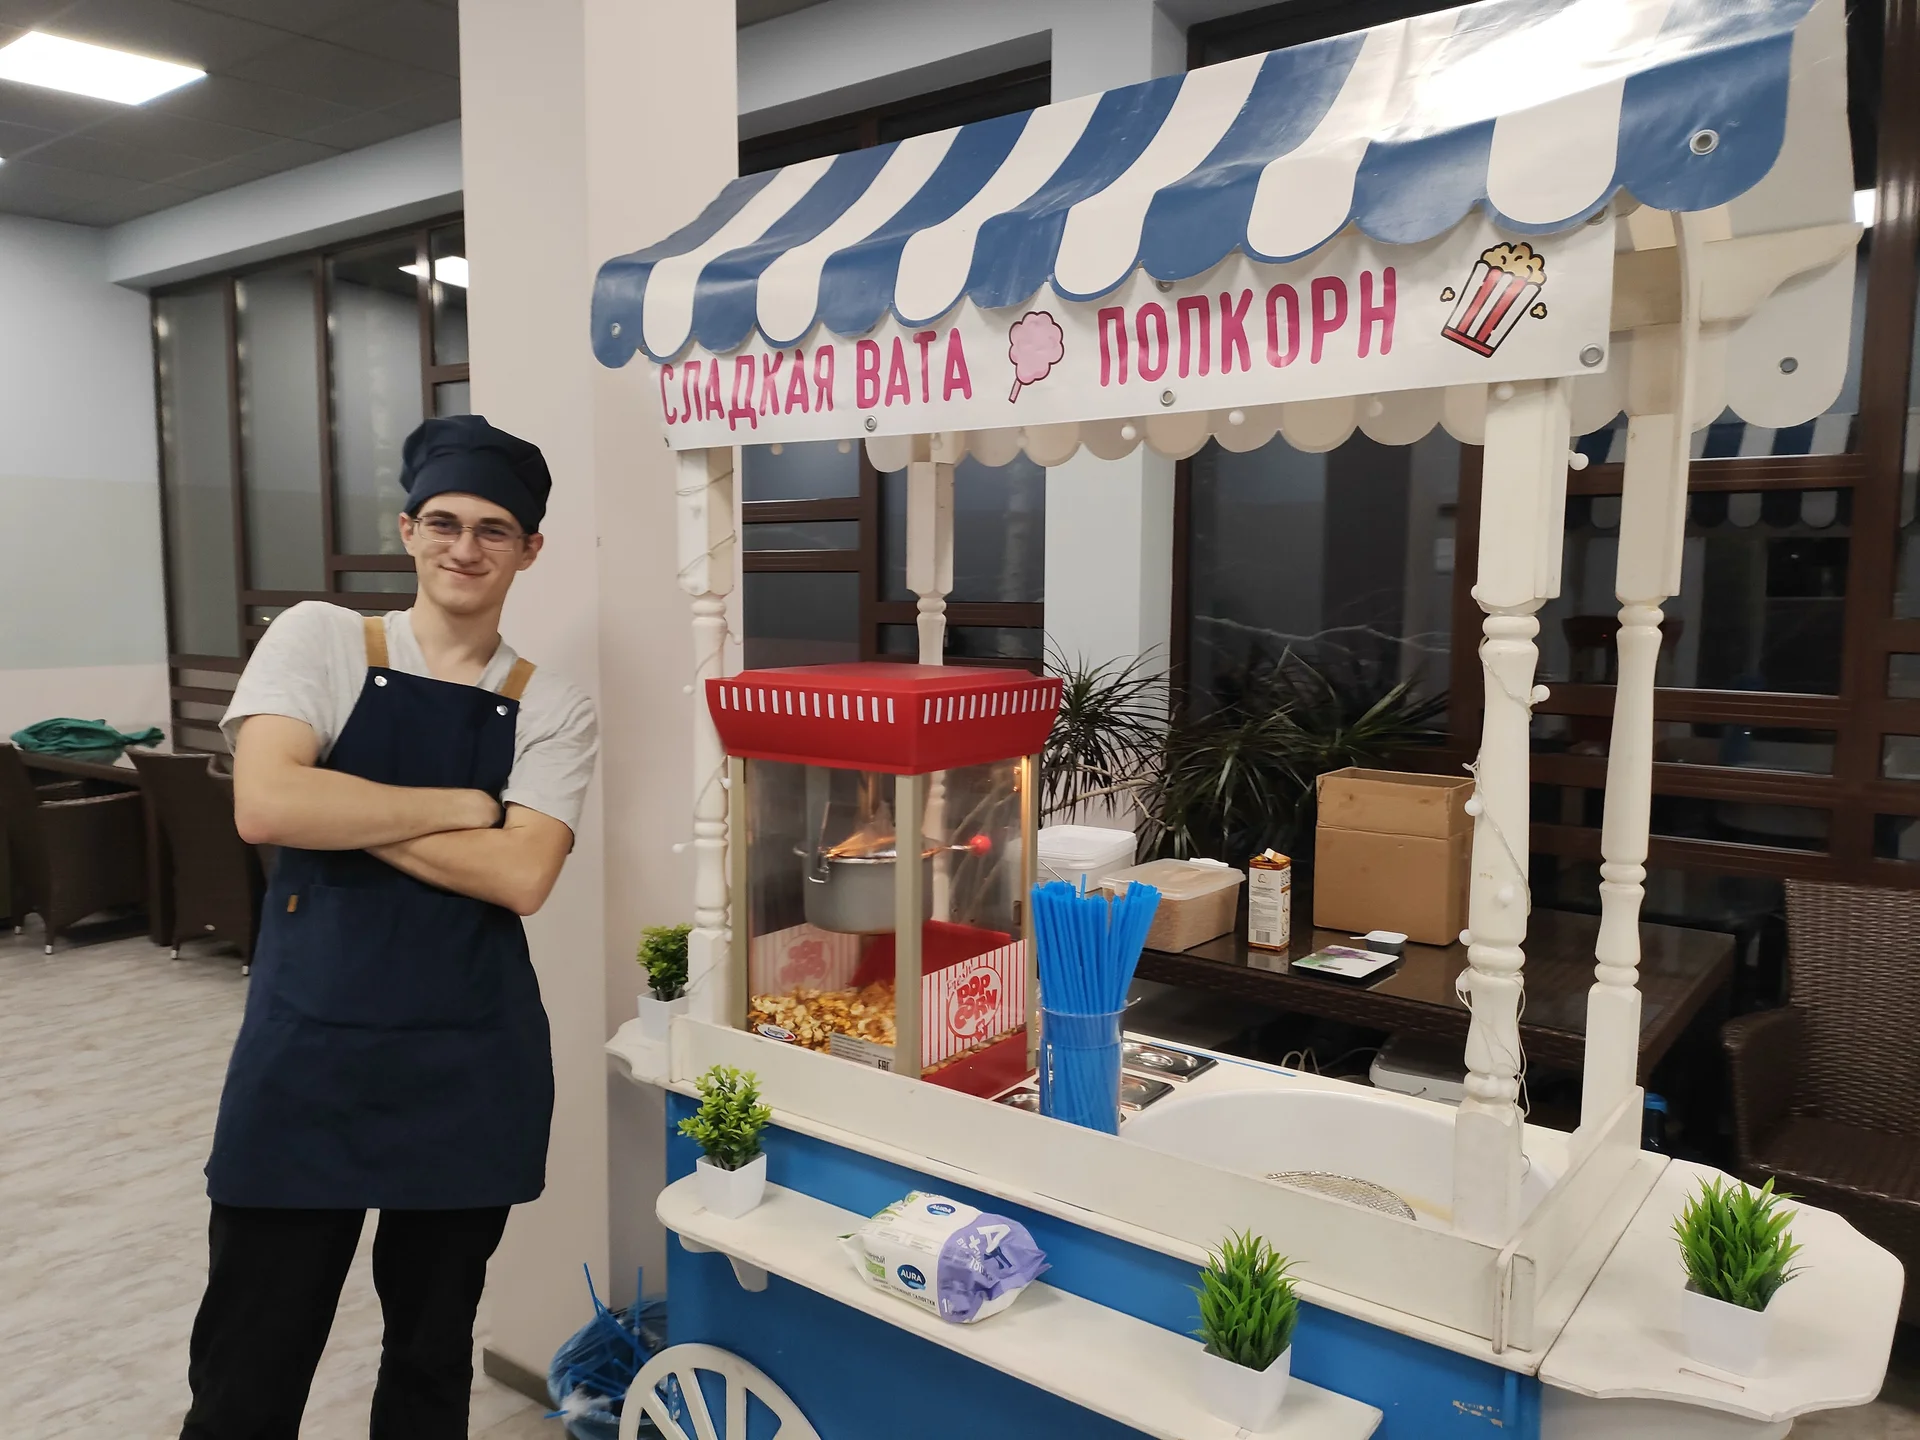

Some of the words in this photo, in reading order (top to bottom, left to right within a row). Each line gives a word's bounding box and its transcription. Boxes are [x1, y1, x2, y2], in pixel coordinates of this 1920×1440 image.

[1097, 266, 1397, 387] ПОПКОРН
[660, 344, 834, 431] СЛАДКАЯ
[855, 327, 973, 409] ВАТА
[954, 989, 998, 1030] CORN
[956, 973, 991, 1006] POP
[900, 1269, 923, 1284] AURA
